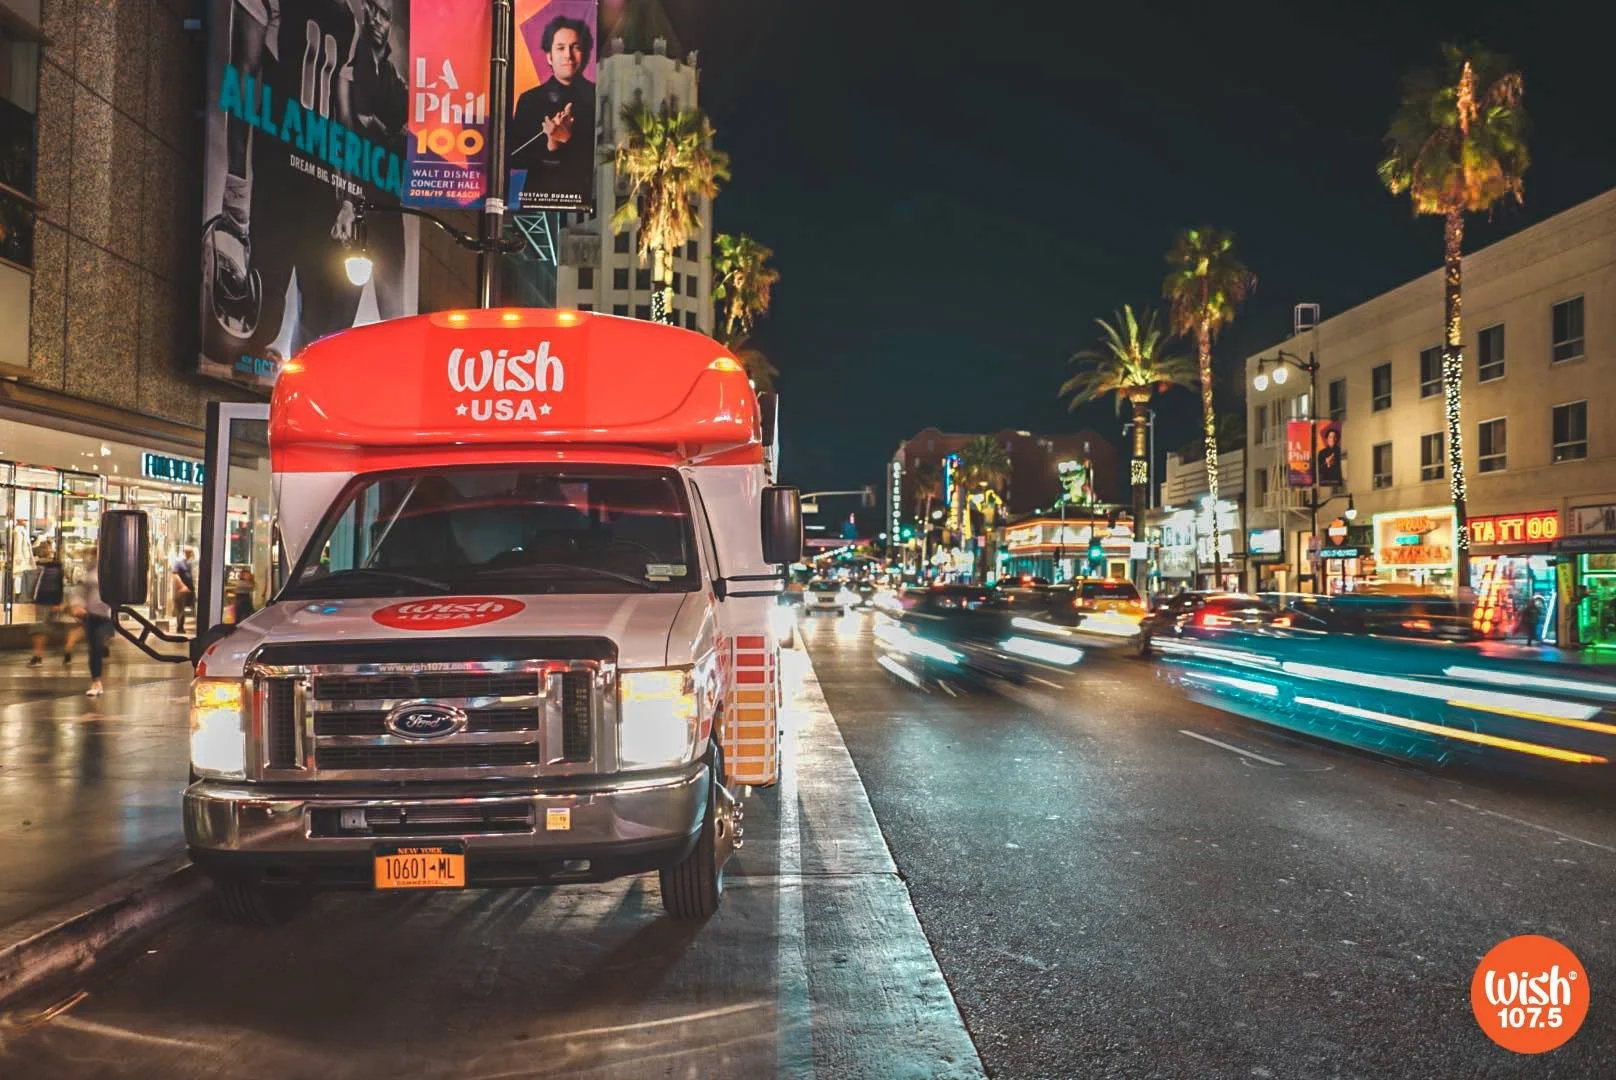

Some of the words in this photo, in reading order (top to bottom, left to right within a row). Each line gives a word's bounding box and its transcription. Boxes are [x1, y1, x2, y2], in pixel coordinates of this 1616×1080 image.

[416, 58, 459, 89] LA
[415, 92, 486, 124] Phil
[219, 64, 277, 136] ALL
[281, 97, 408, 199] AMERICA
[416, 128, 484, 156] 100
[290, 154, 316, 176] DREAM
[331, 173, 347, 190] STAY
[412, 169, 439, 178] WALT
[443, 170, 480, 179] DISNEY
[411, 179, 454, 189] CONCERT
[446, 190, 480, 198] SEASON
[471, 399, 537, 420] USA
[1471, 516, 1557, 542] TATTOO
[406, 714, 442, 728] Ford
[386, 858, 426, 879] 10601
